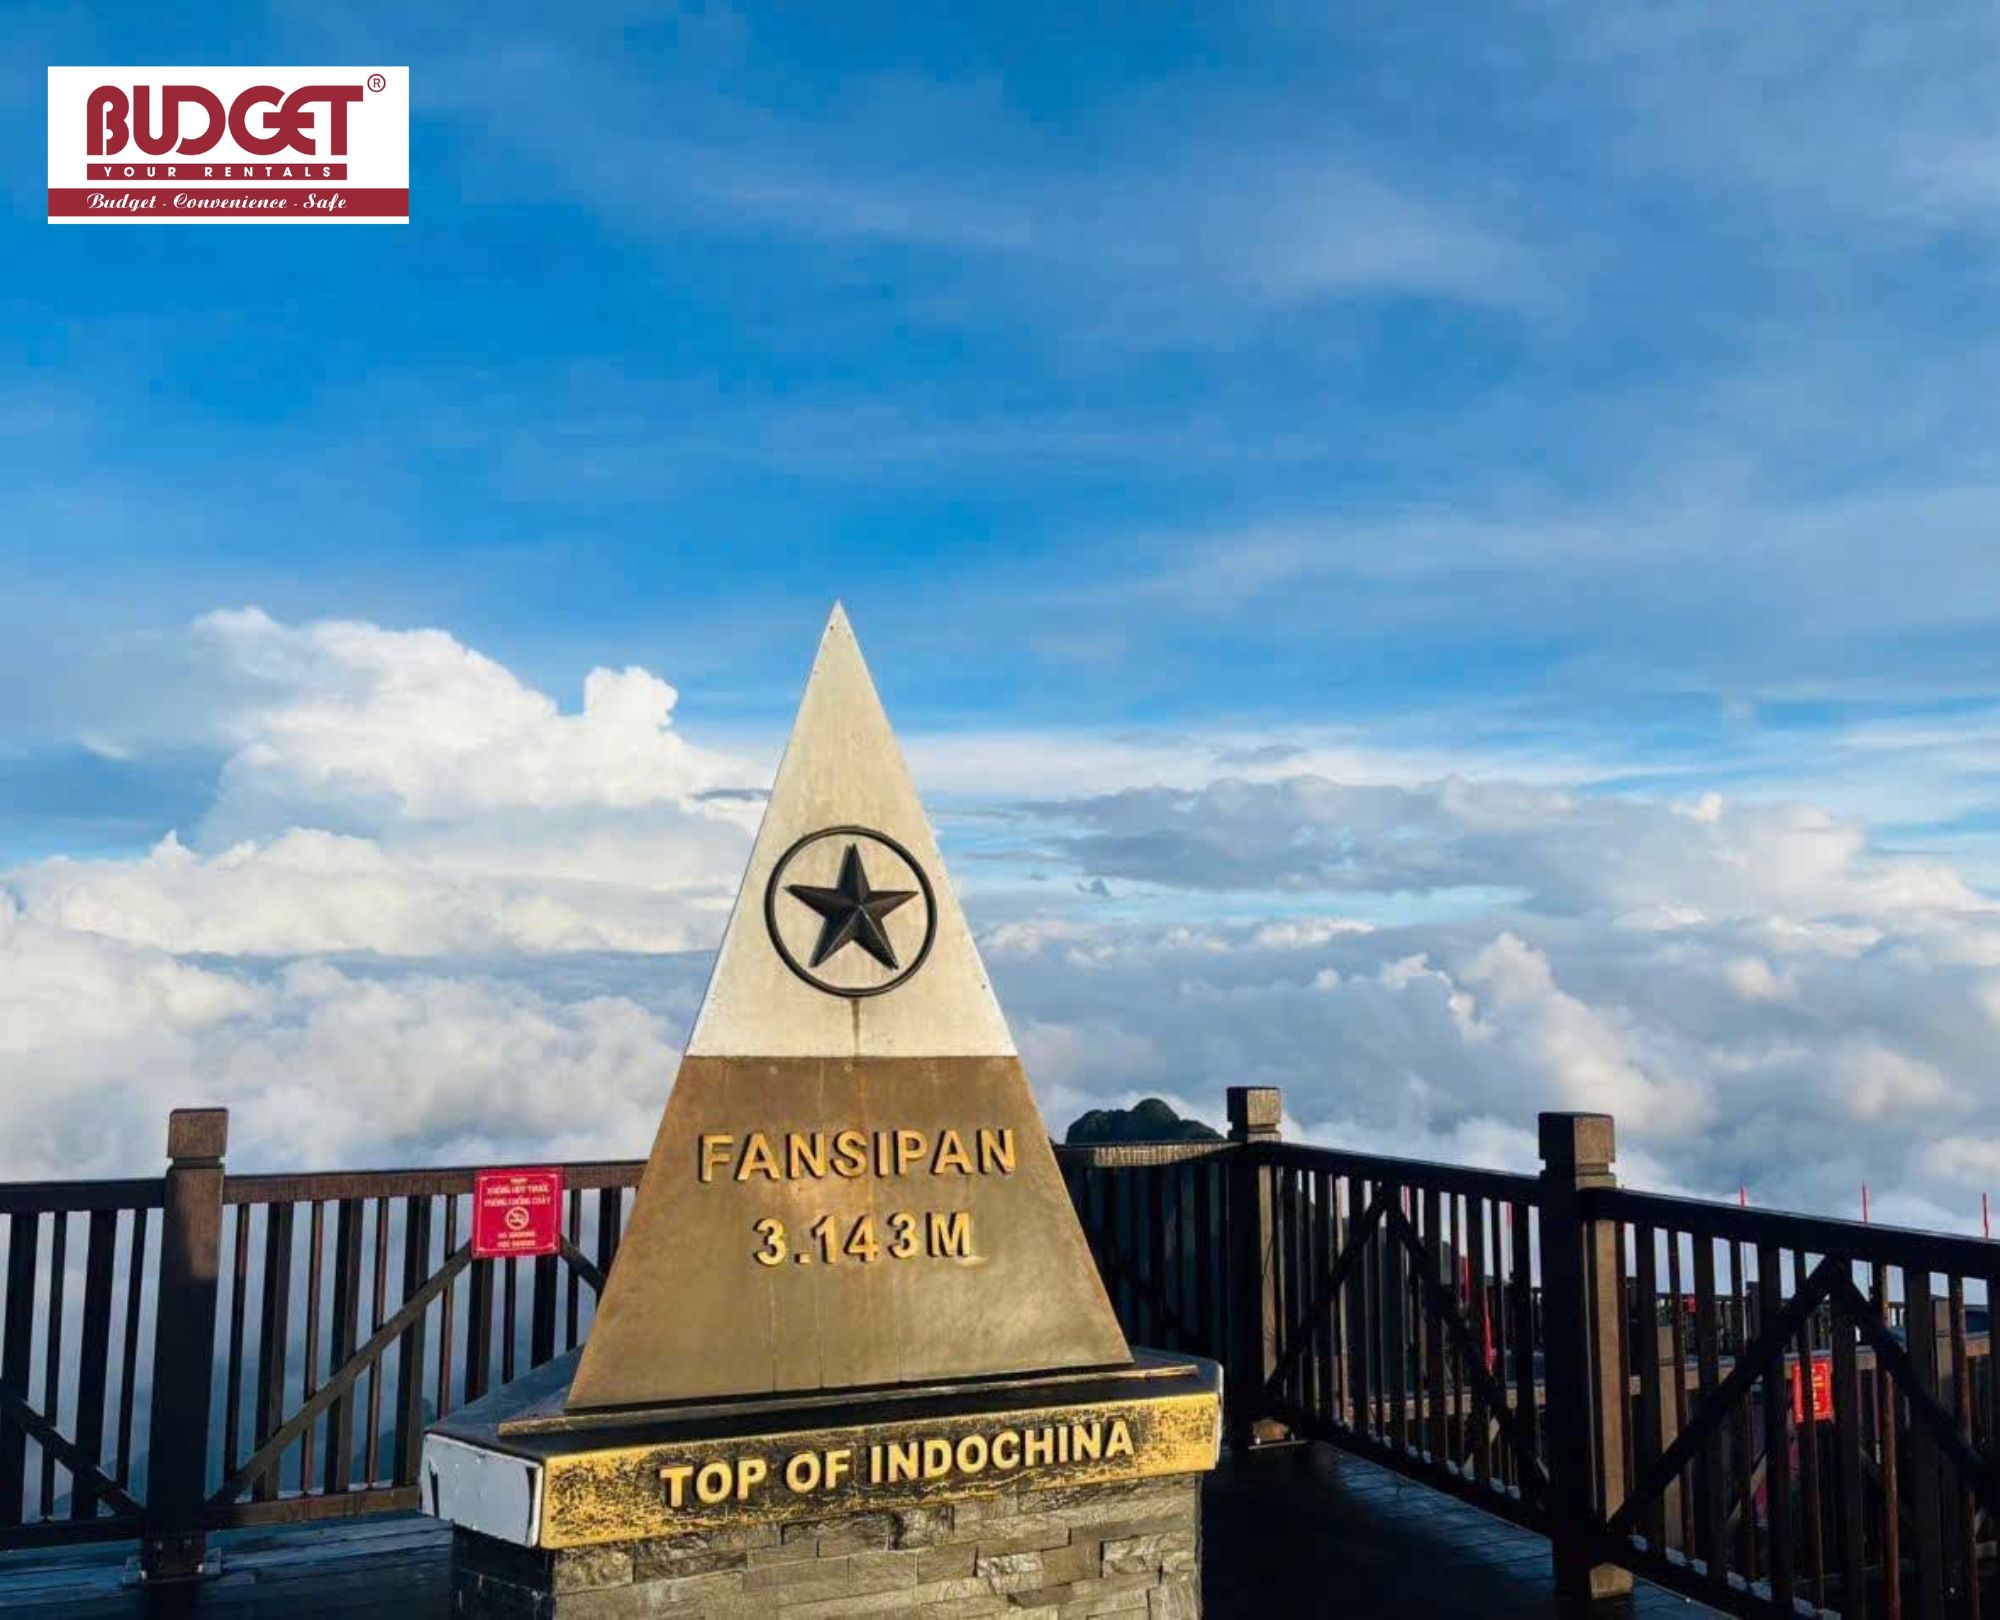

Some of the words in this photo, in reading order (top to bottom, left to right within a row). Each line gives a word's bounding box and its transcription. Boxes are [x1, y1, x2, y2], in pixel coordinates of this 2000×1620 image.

[699, 1129, 1017, 1183] FANSIPAN
[753, 1211, 972, 1267] 3.143M
[659, 1456, 768, 1509] TOP
[785, 1448, 852, 1494] OF
[870, 1419, 1135, 1484] INDOCHINA
